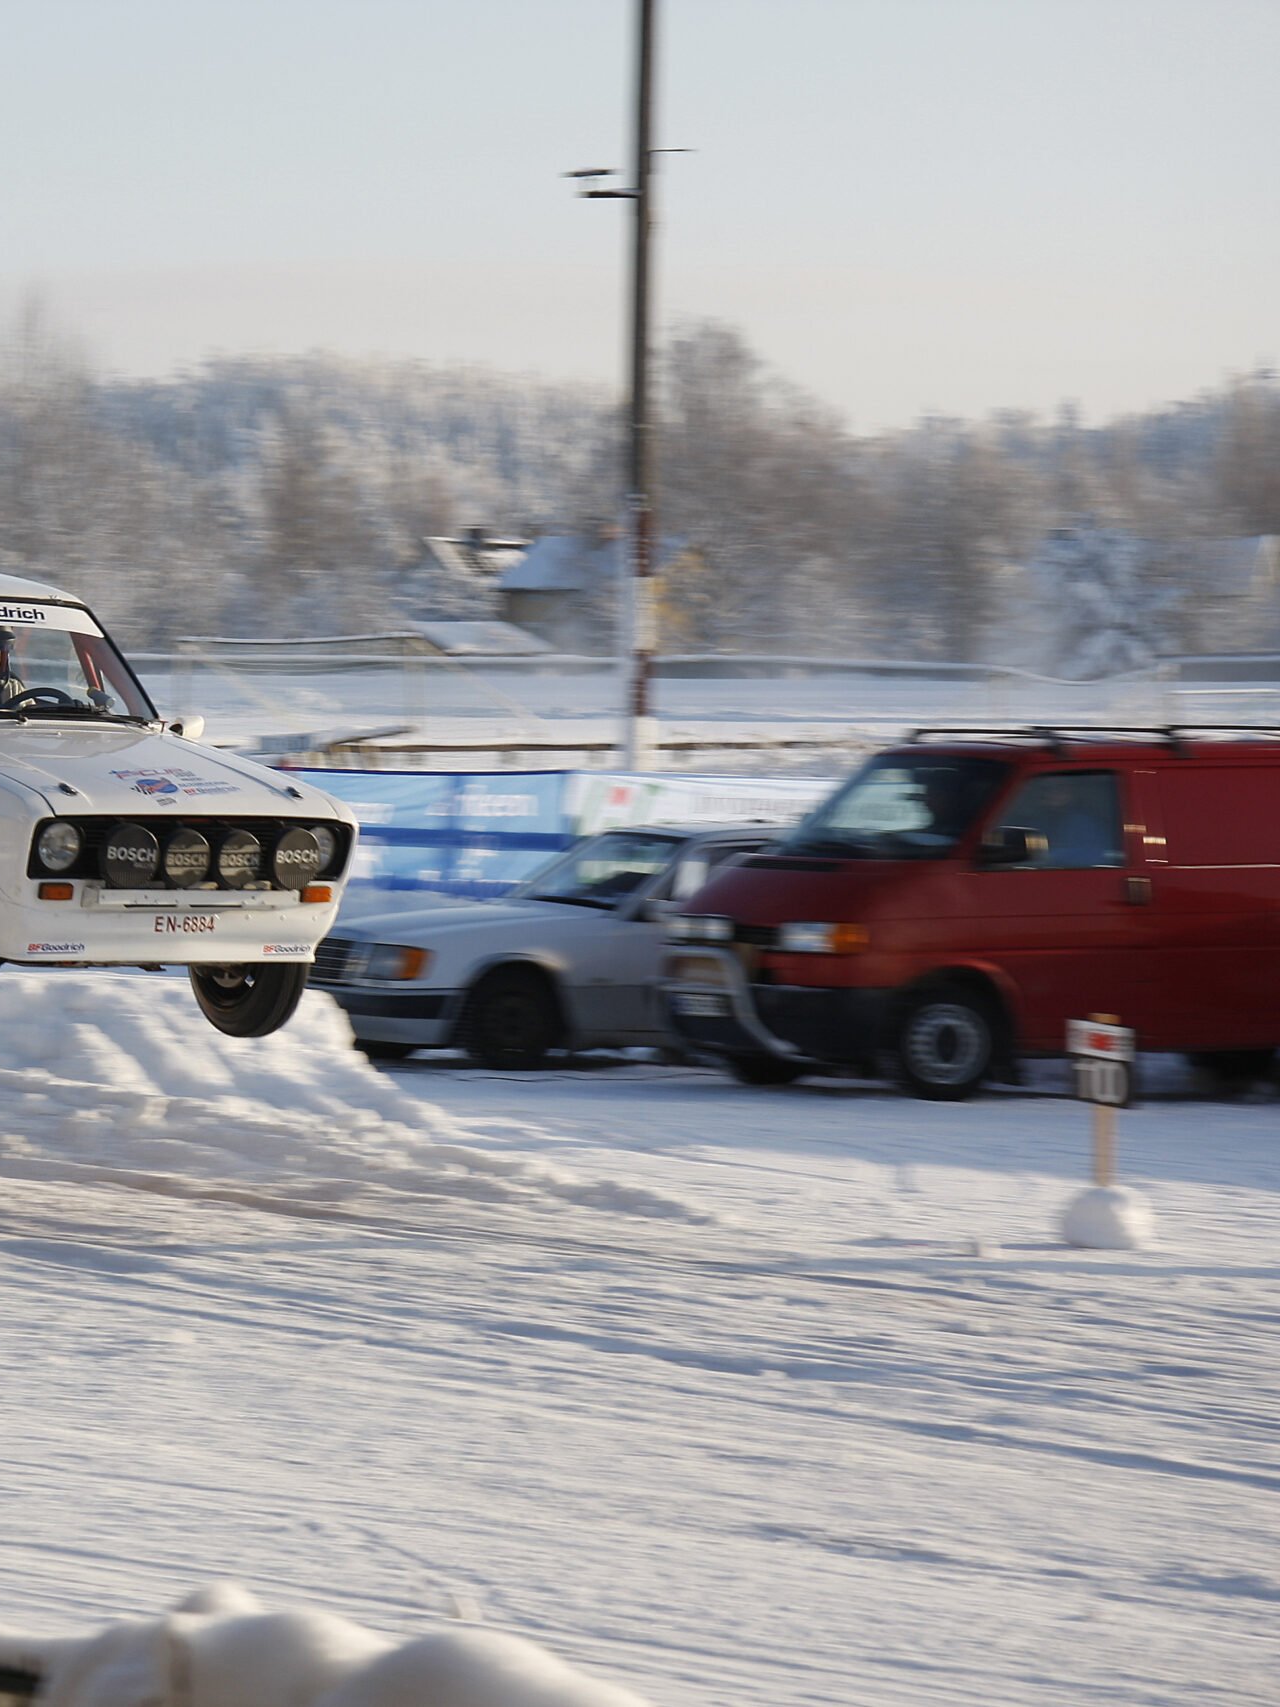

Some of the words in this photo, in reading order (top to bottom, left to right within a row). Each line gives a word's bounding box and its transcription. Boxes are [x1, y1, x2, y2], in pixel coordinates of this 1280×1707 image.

[107, 846, 157, 862] BOSCH
[167, 853, 208, 866] BOSCH
[220, 853, 260, 867] BOSCH
[276, 849, 319, 864] BOSCH
[155, 915, 215, 933] EN-6884
[28, 942, 85, 951] BFGoodrich
[263, 944, 311, 953] BFGoodrich
